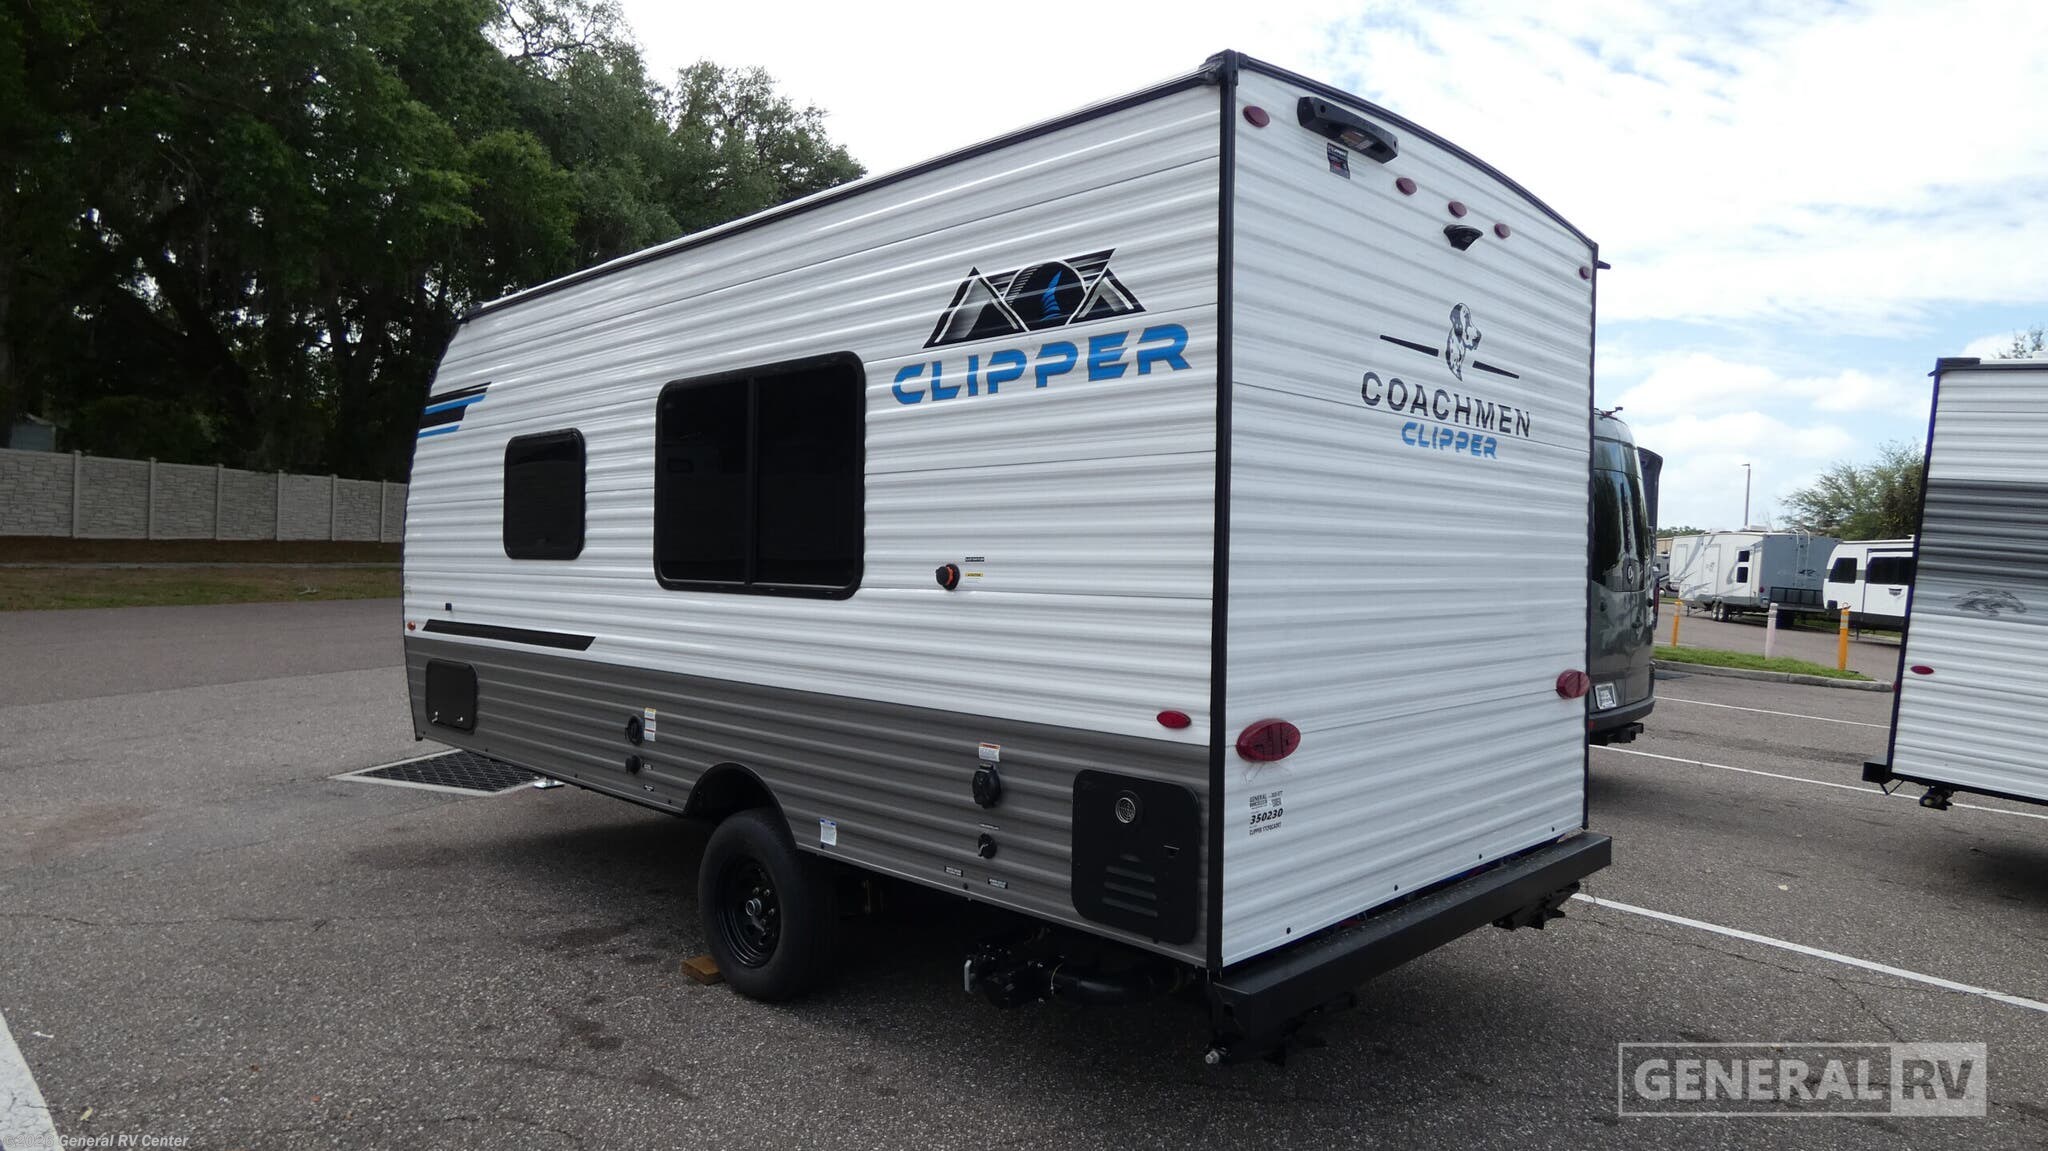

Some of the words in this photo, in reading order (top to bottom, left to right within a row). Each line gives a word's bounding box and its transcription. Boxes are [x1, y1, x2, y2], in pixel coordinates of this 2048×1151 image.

[891, 323, 1192, 405] CLIPPER
[1361, 371, 1531, 438] COACHMEN
[1401, 421, 1498, 459] CLIPPER
[1250, 808, 1284, 825] 350230
